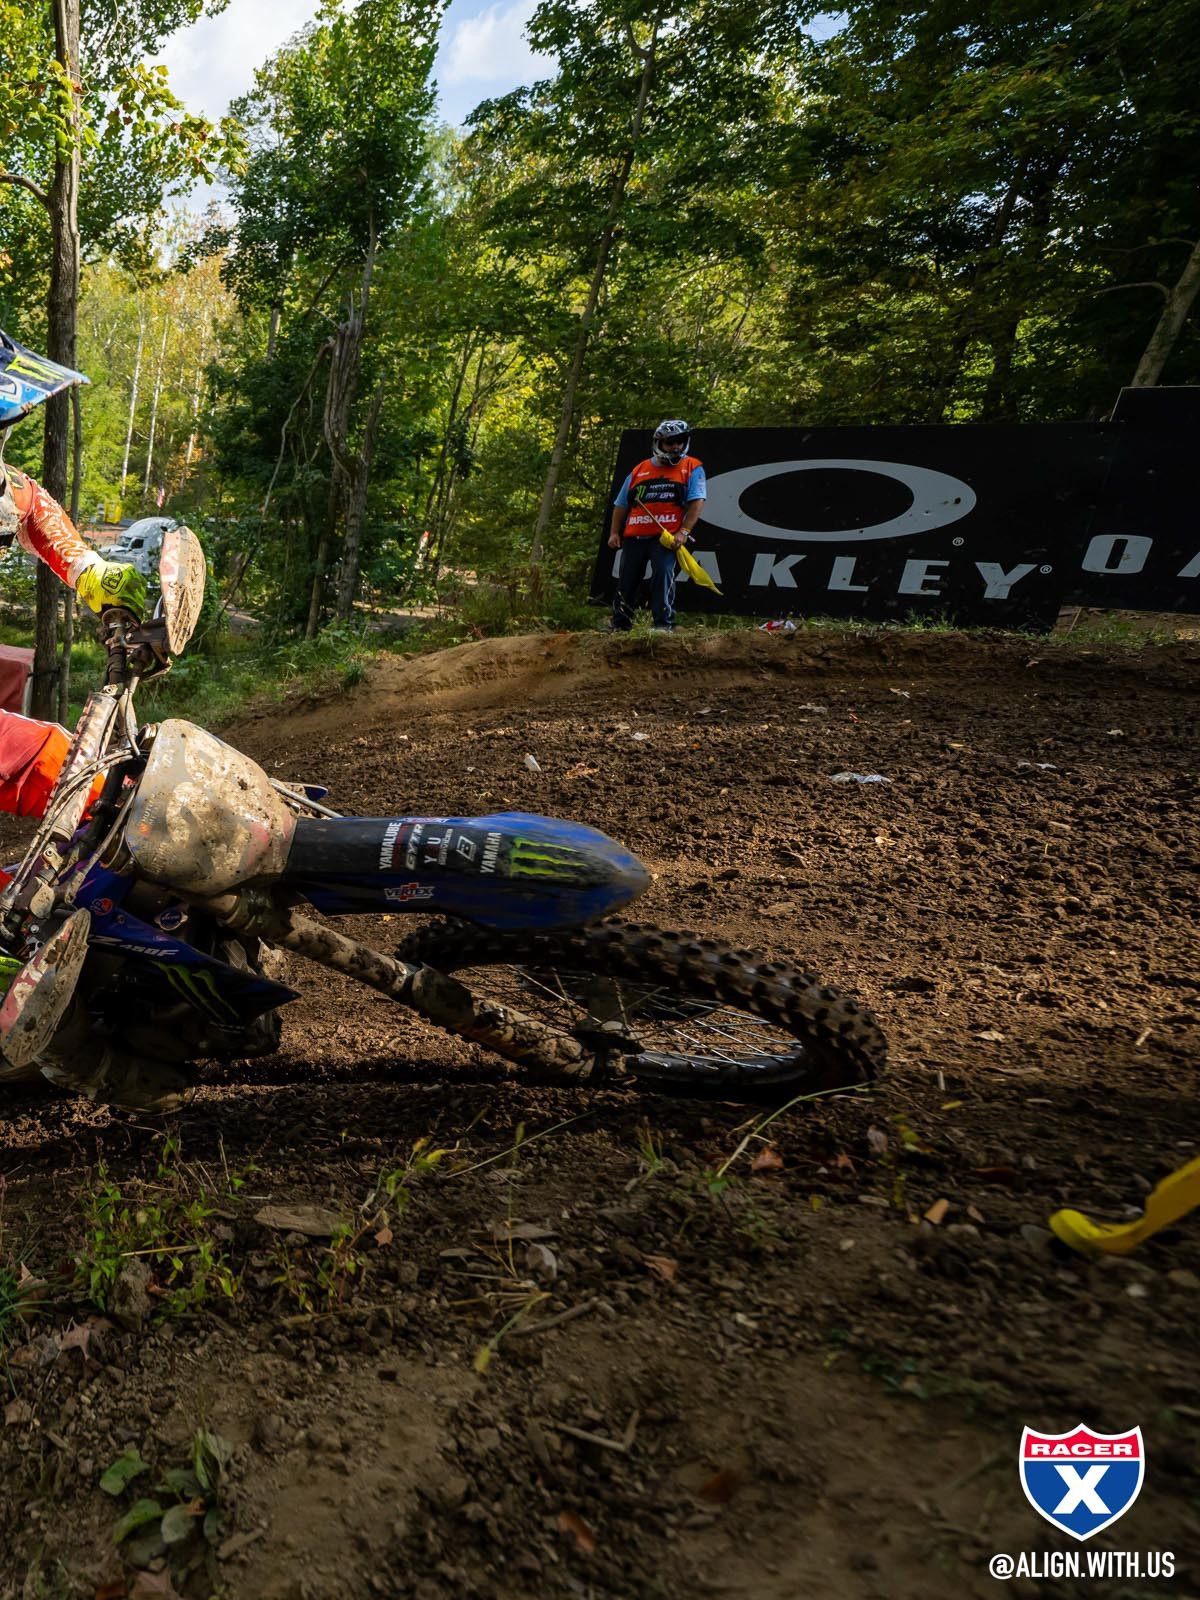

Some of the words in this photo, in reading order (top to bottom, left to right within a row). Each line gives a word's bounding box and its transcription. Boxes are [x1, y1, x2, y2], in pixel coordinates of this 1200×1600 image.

[379, 822, 402, 870] YAMALUBE
[405, 823, 425, 871] GYTR
[480, 832, 502, 873] YAMAHA
[384, 886, 435, 898] VERTEX
